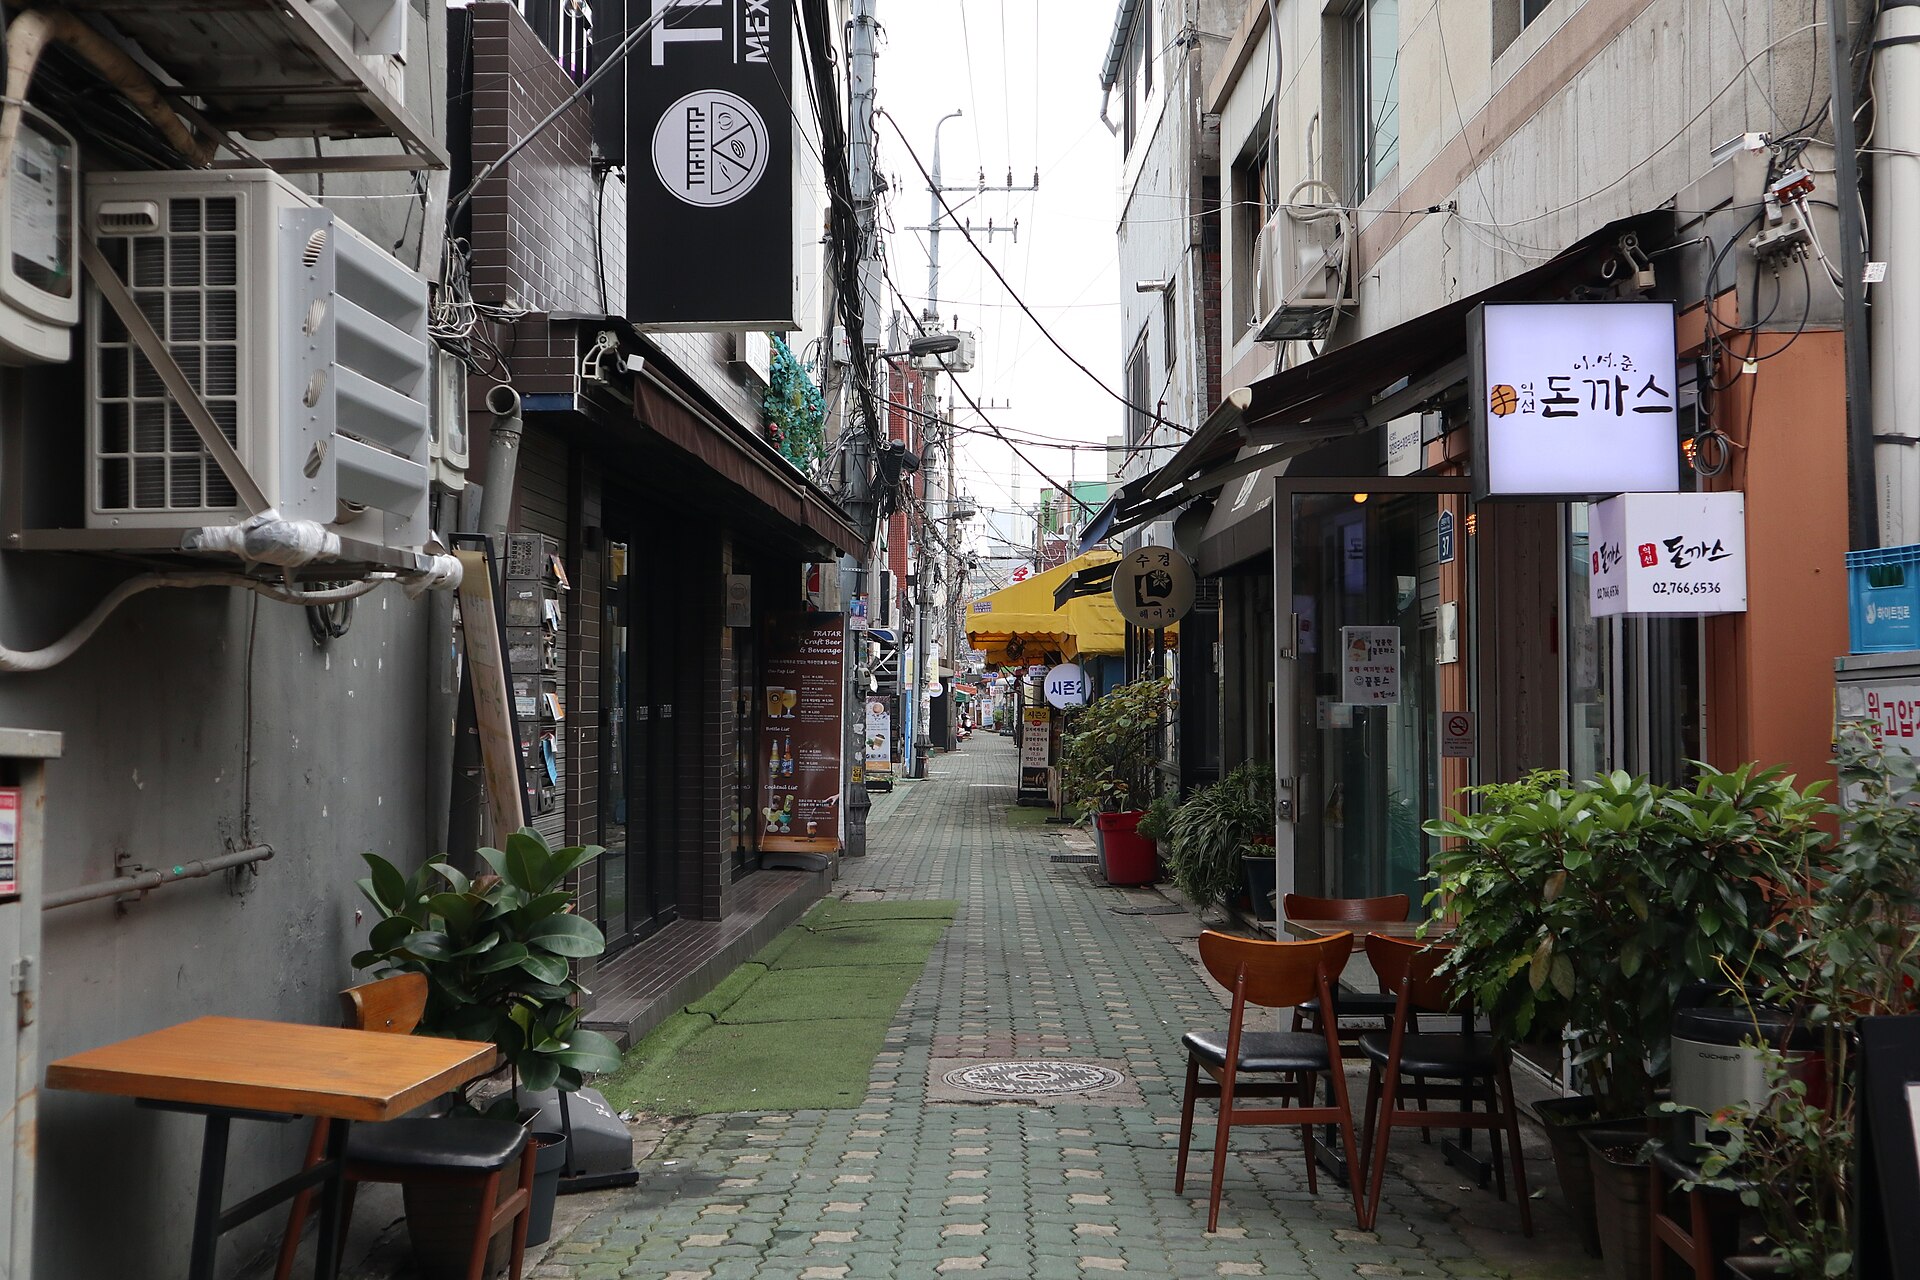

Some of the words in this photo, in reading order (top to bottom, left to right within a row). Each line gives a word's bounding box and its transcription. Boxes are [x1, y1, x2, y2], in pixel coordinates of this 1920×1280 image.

[1520, 382, 1536, 414] 익선
[1540, 374, 1674, 417] 돈까스
[1442, 535, 1450, 556] 37
[1652, 582, 1721, 595] 02.766.6536
[1876, 605, 1911, 620] 하이트진로
[804, 638, 823, 646] Craft
[807, 647, 842, 655] Beverage
[1027, 711, 1047, 720] 시즌2
